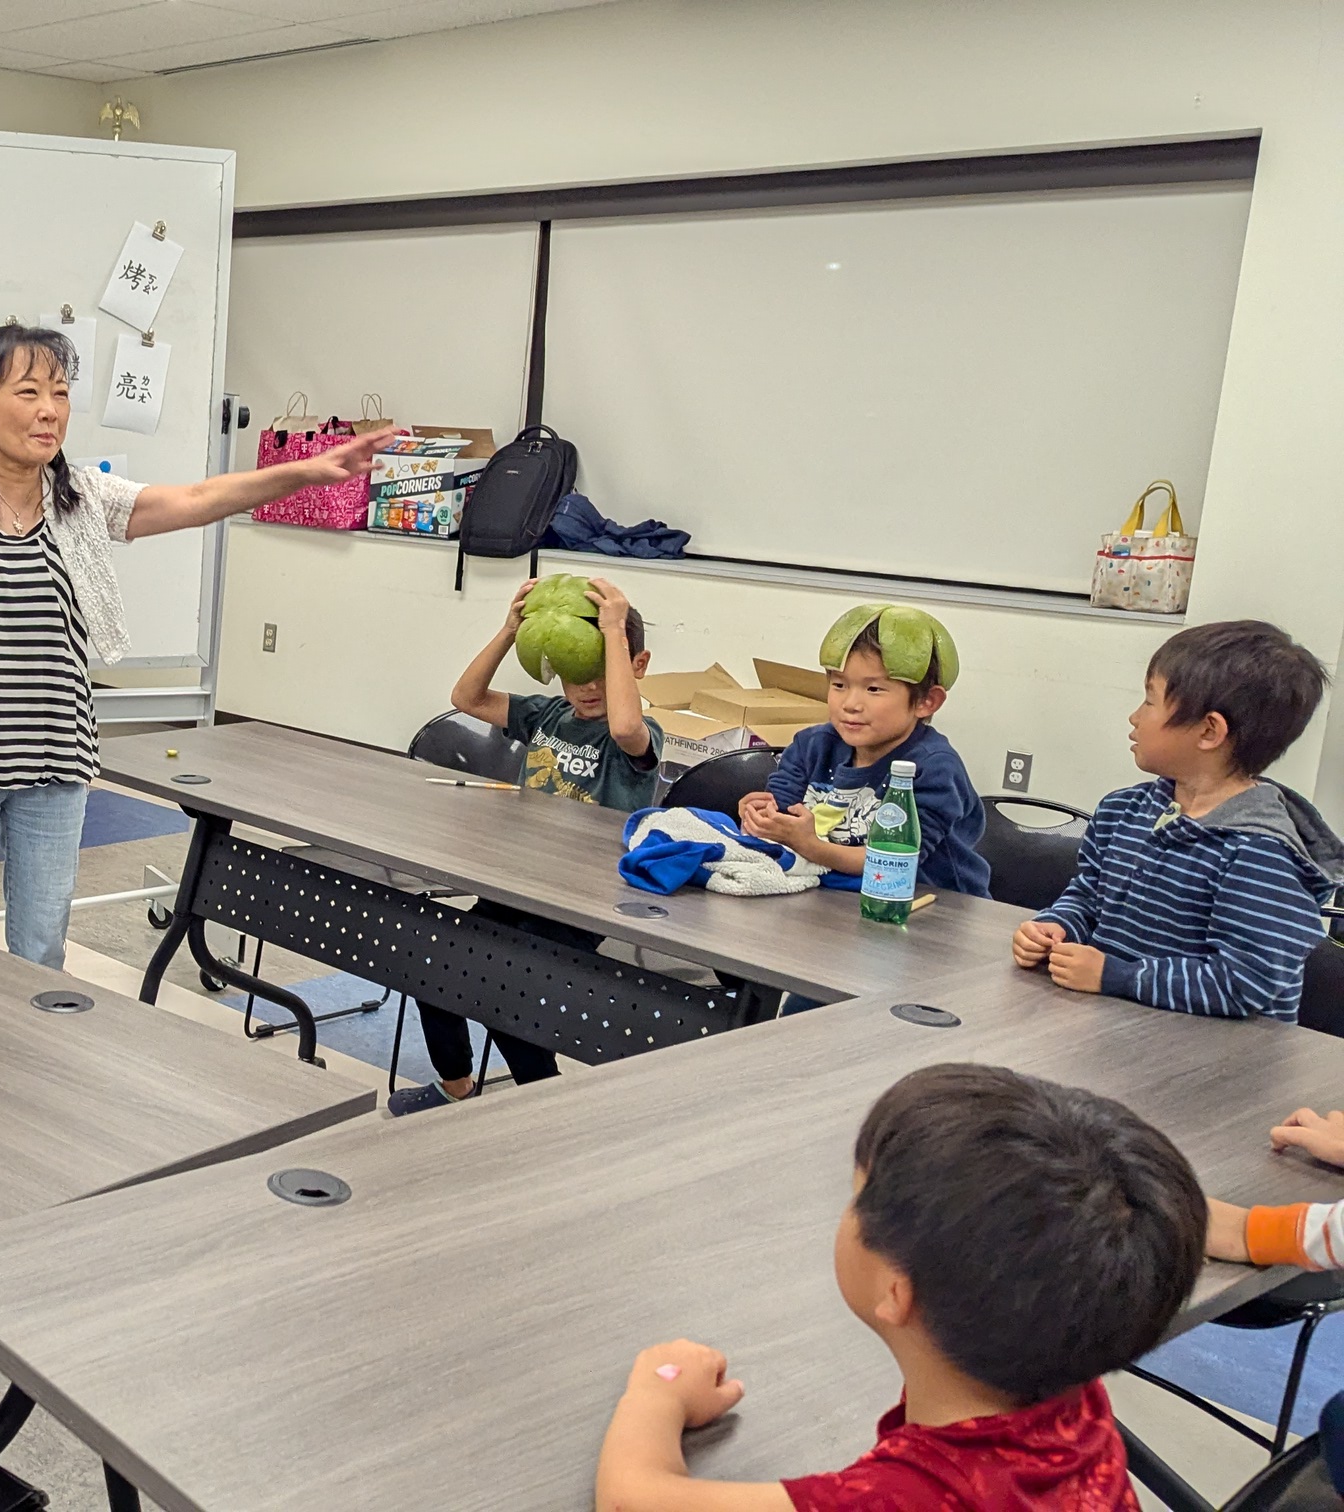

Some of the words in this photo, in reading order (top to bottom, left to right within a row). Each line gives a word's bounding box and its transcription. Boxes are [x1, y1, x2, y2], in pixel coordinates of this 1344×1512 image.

[118, 259, 147, 291] 烤
[116, 371, 138, 400] 亮
[381, 476, 443, 497] POPCORNERS
[439, 509, 448, 519] 30
[664, 736, 709, 754] ATHFINDER
[554, 750, 599, 778] Rex
